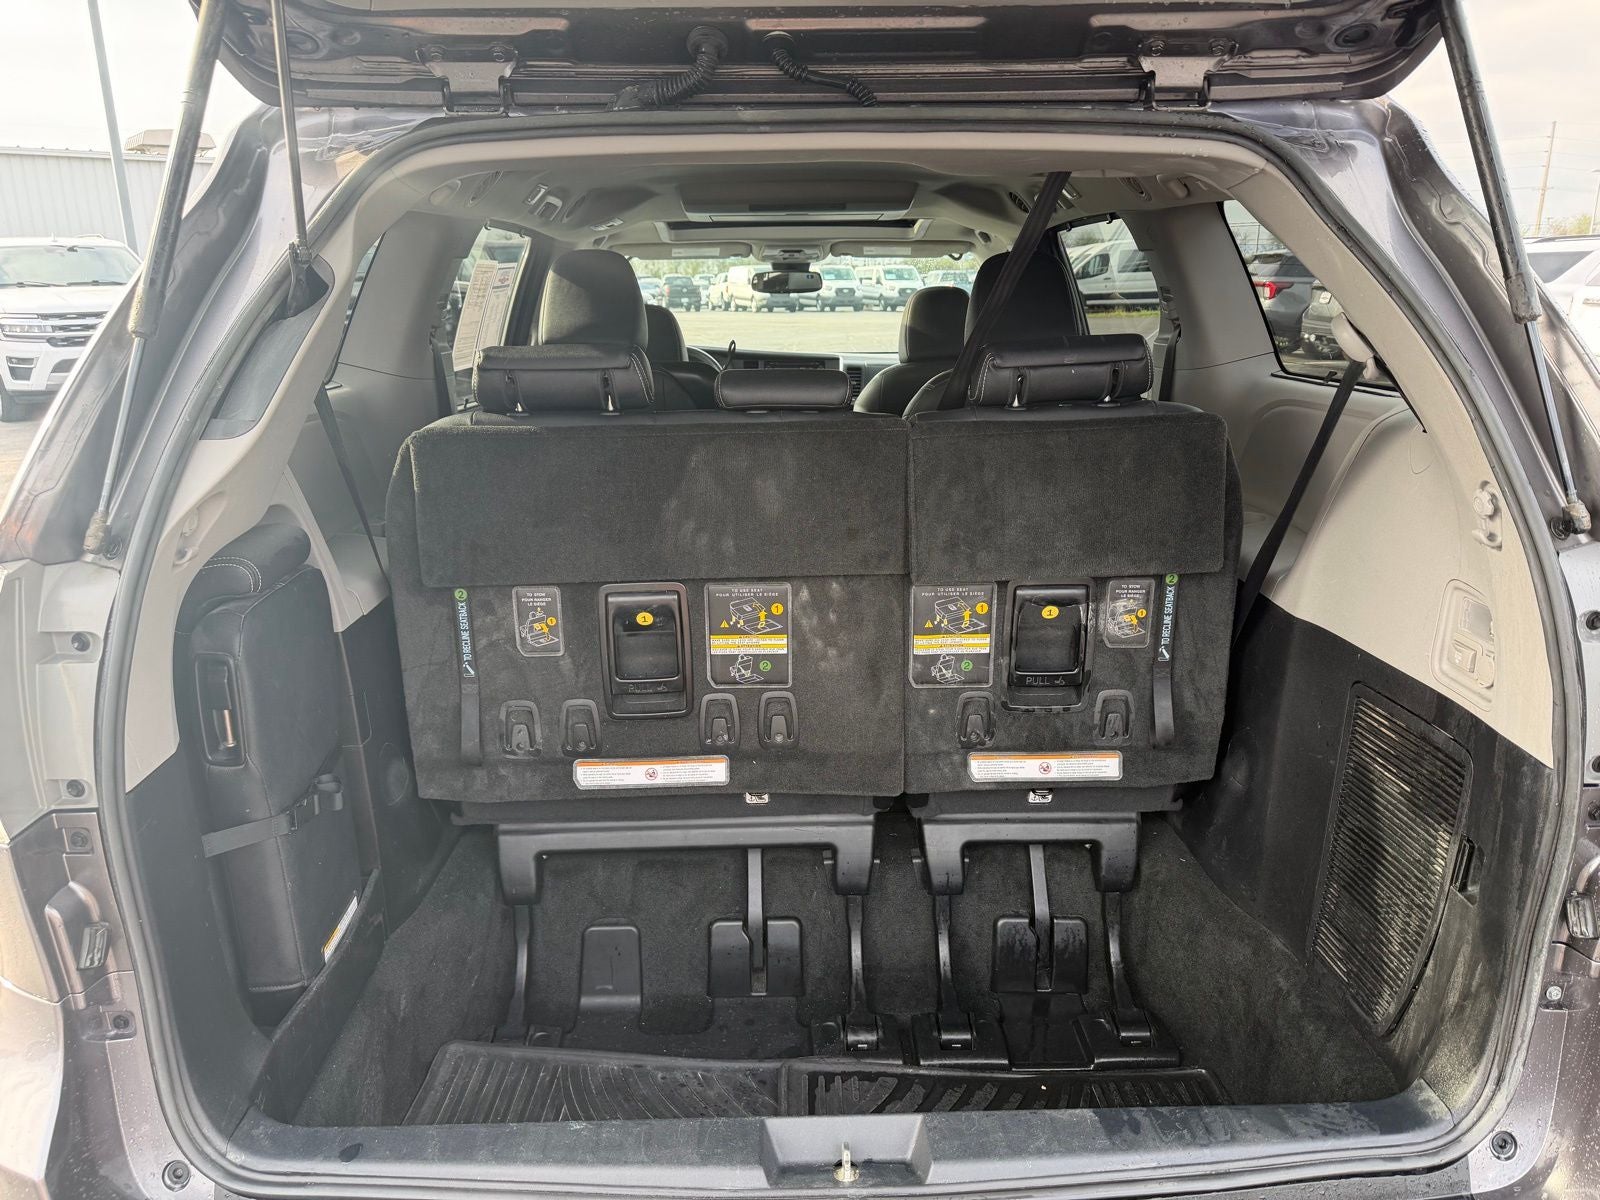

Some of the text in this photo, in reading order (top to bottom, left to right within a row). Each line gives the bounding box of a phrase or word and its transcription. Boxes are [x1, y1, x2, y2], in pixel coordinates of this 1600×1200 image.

[458, 601, 472, 661] TO RECLINE SEATBACK
[1161, 586, 1175, 645] TO RECLINE SEATBACK
[1025, 676, 1050, 685] PULL
